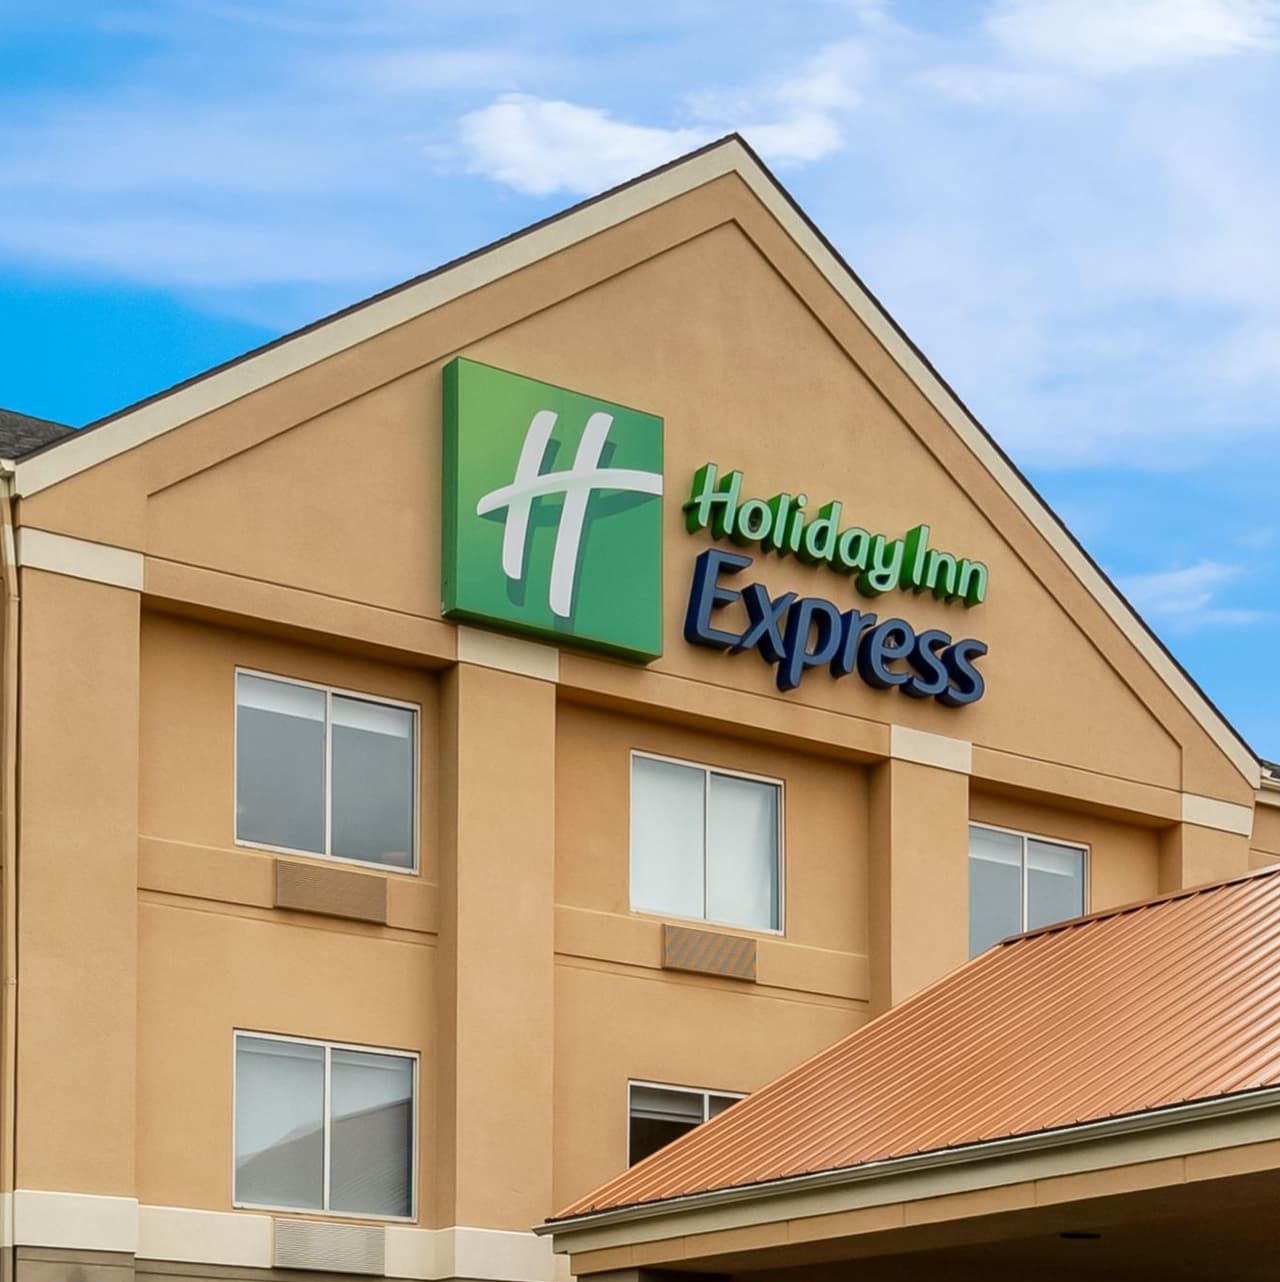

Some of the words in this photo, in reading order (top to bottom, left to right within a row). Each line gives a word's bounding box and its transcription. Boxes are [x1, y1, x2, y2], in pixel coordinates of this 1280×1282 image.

[682, 462, 905, 598] Holiday
[899, 523, 989, 608] Inn
[683, 548, 989, 707] Express
